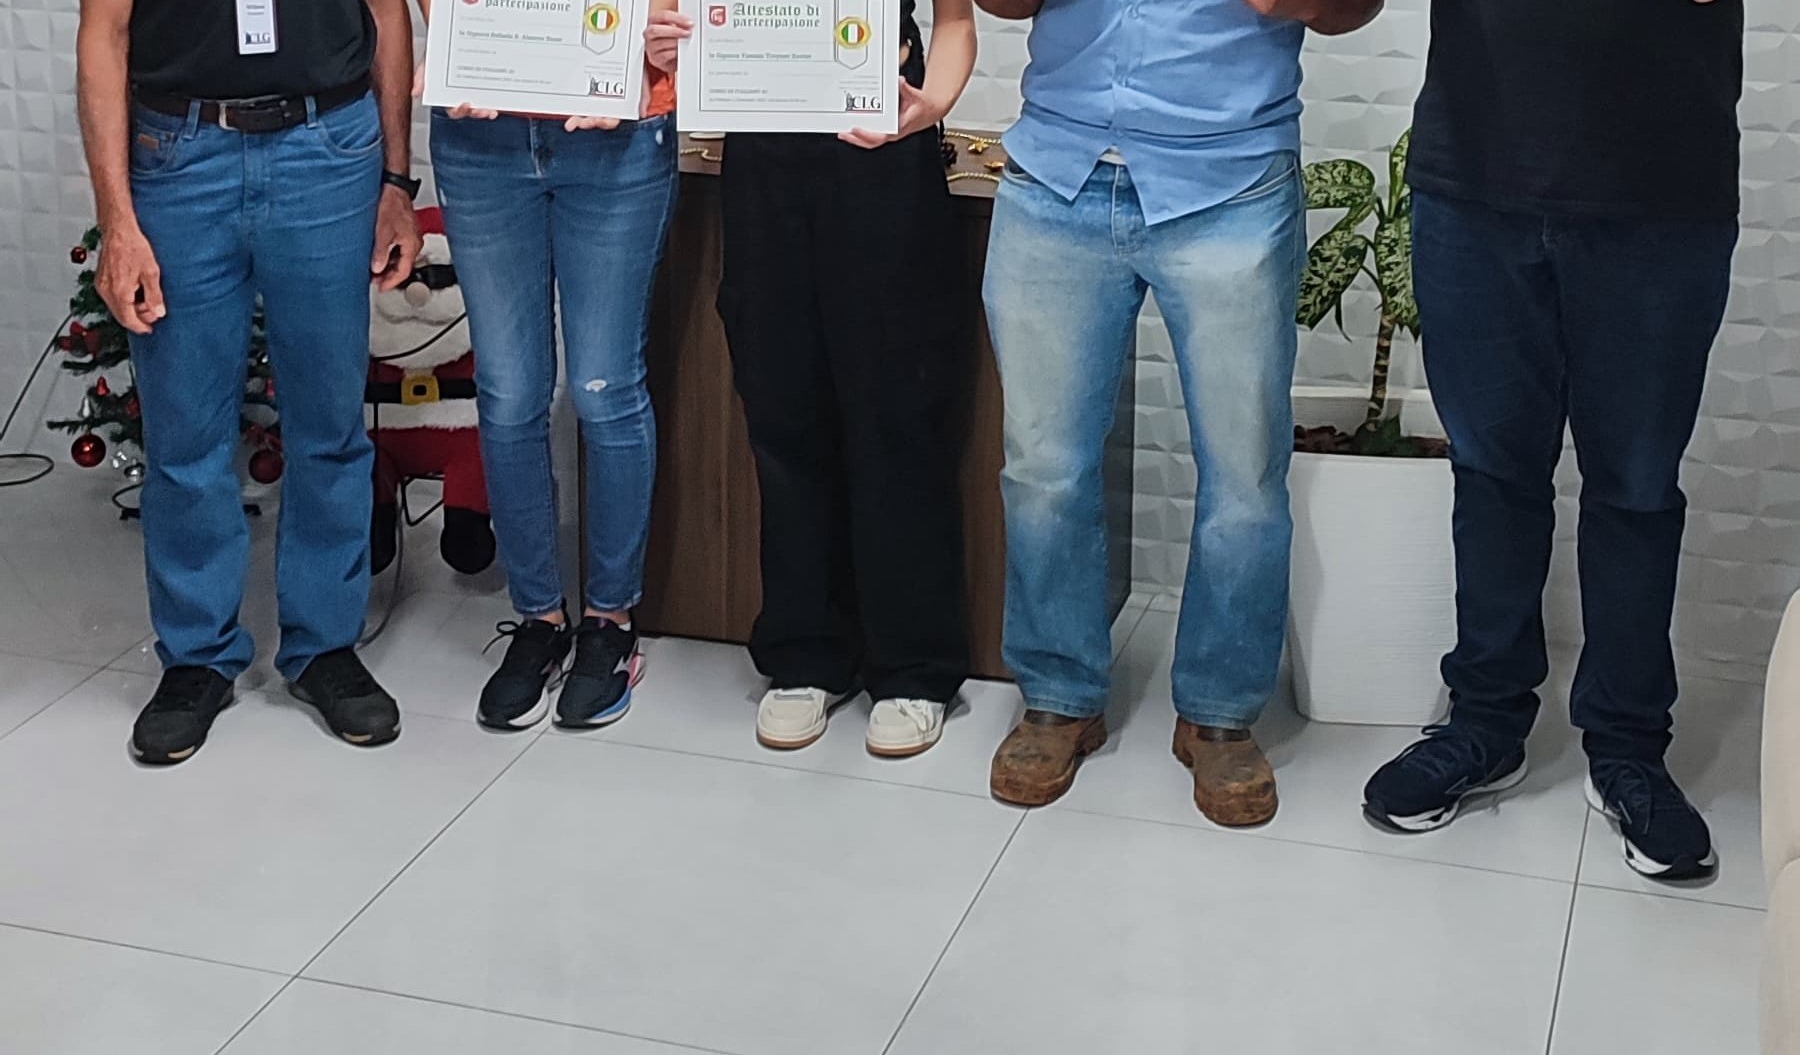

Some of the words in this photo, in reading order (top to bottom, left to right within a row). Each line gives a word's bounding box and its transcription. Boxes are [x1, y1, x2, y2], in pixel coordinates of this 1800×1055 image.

[732, 2, 801, 16] Attestato
[806, 3, 820, 16] di
[733, 16, 820, 29] partecipazione
[596, 81, 624, 95] CLG
[853, 95, 881, 109] CLG
